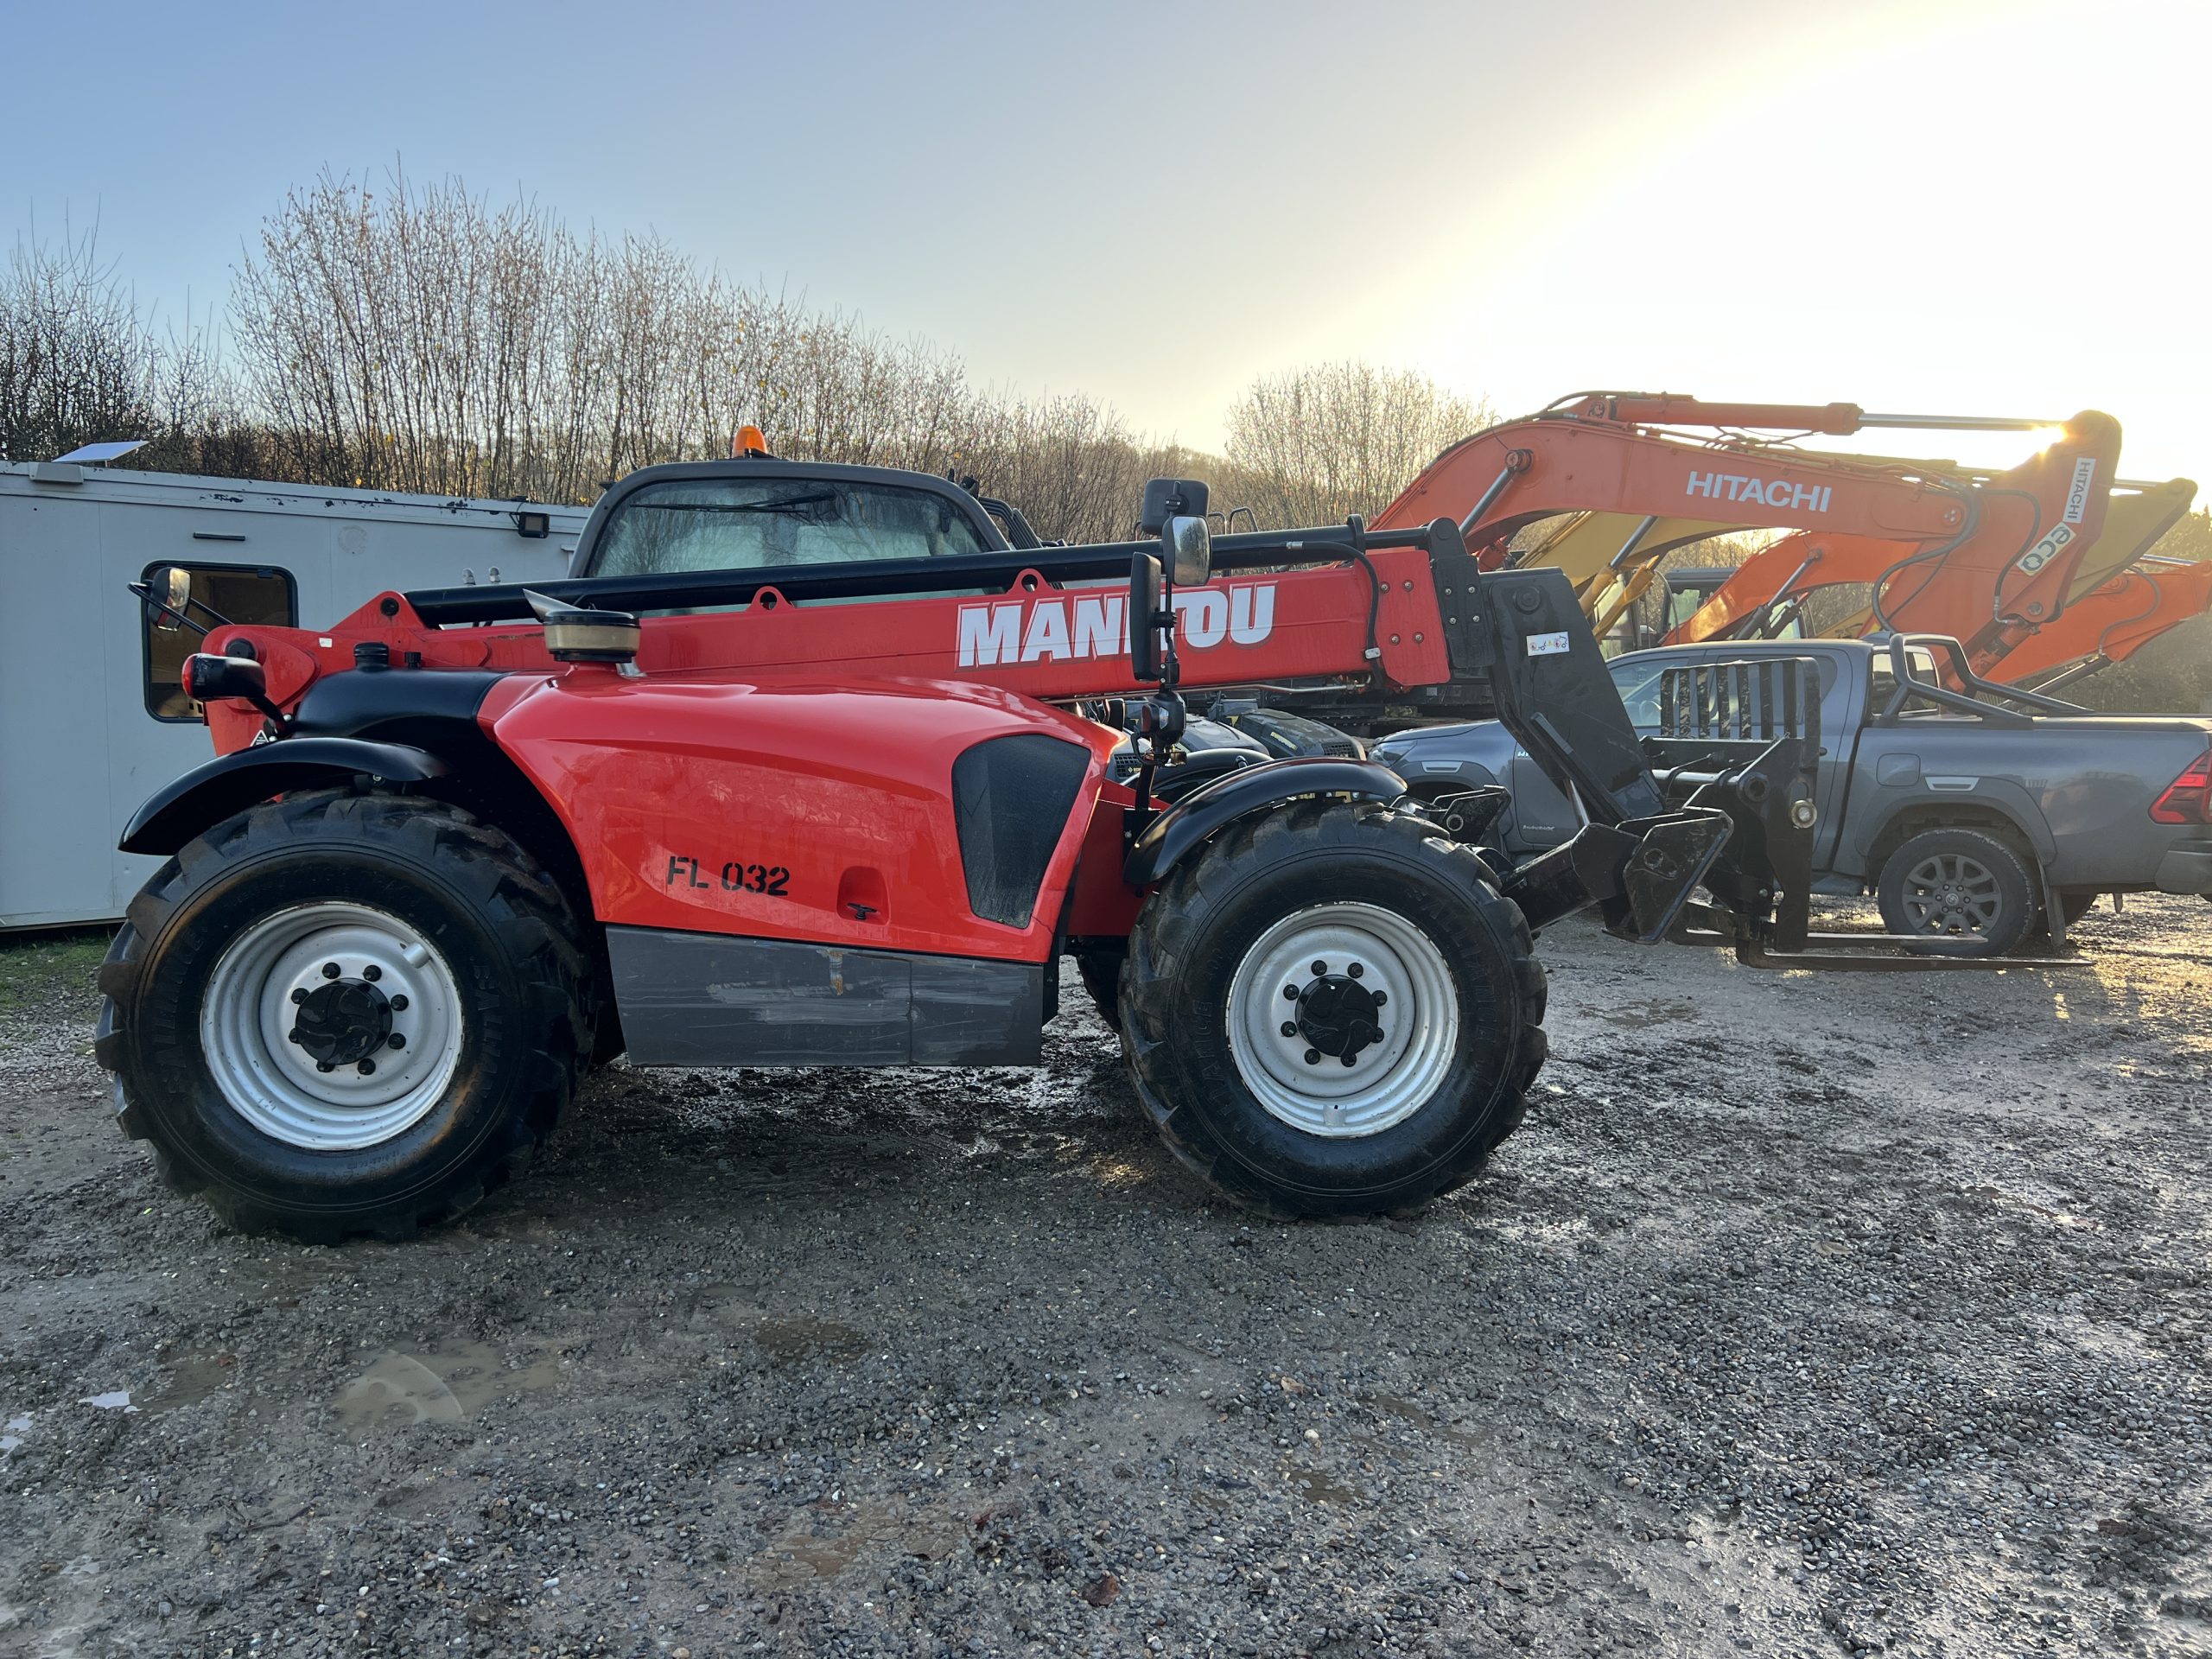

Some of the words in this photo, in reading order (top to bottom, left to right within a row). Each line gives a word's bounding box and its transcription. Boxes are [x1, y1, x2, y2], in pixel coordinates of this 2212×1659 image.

[1686, 470, 1833, 512] HITACHI
[2067, 461, 2091, 520] HITACHI
[2022, 525, 2071, 571] eco
[667, 855, 709, 889] FL
[721, 862, 790, 896] 032
